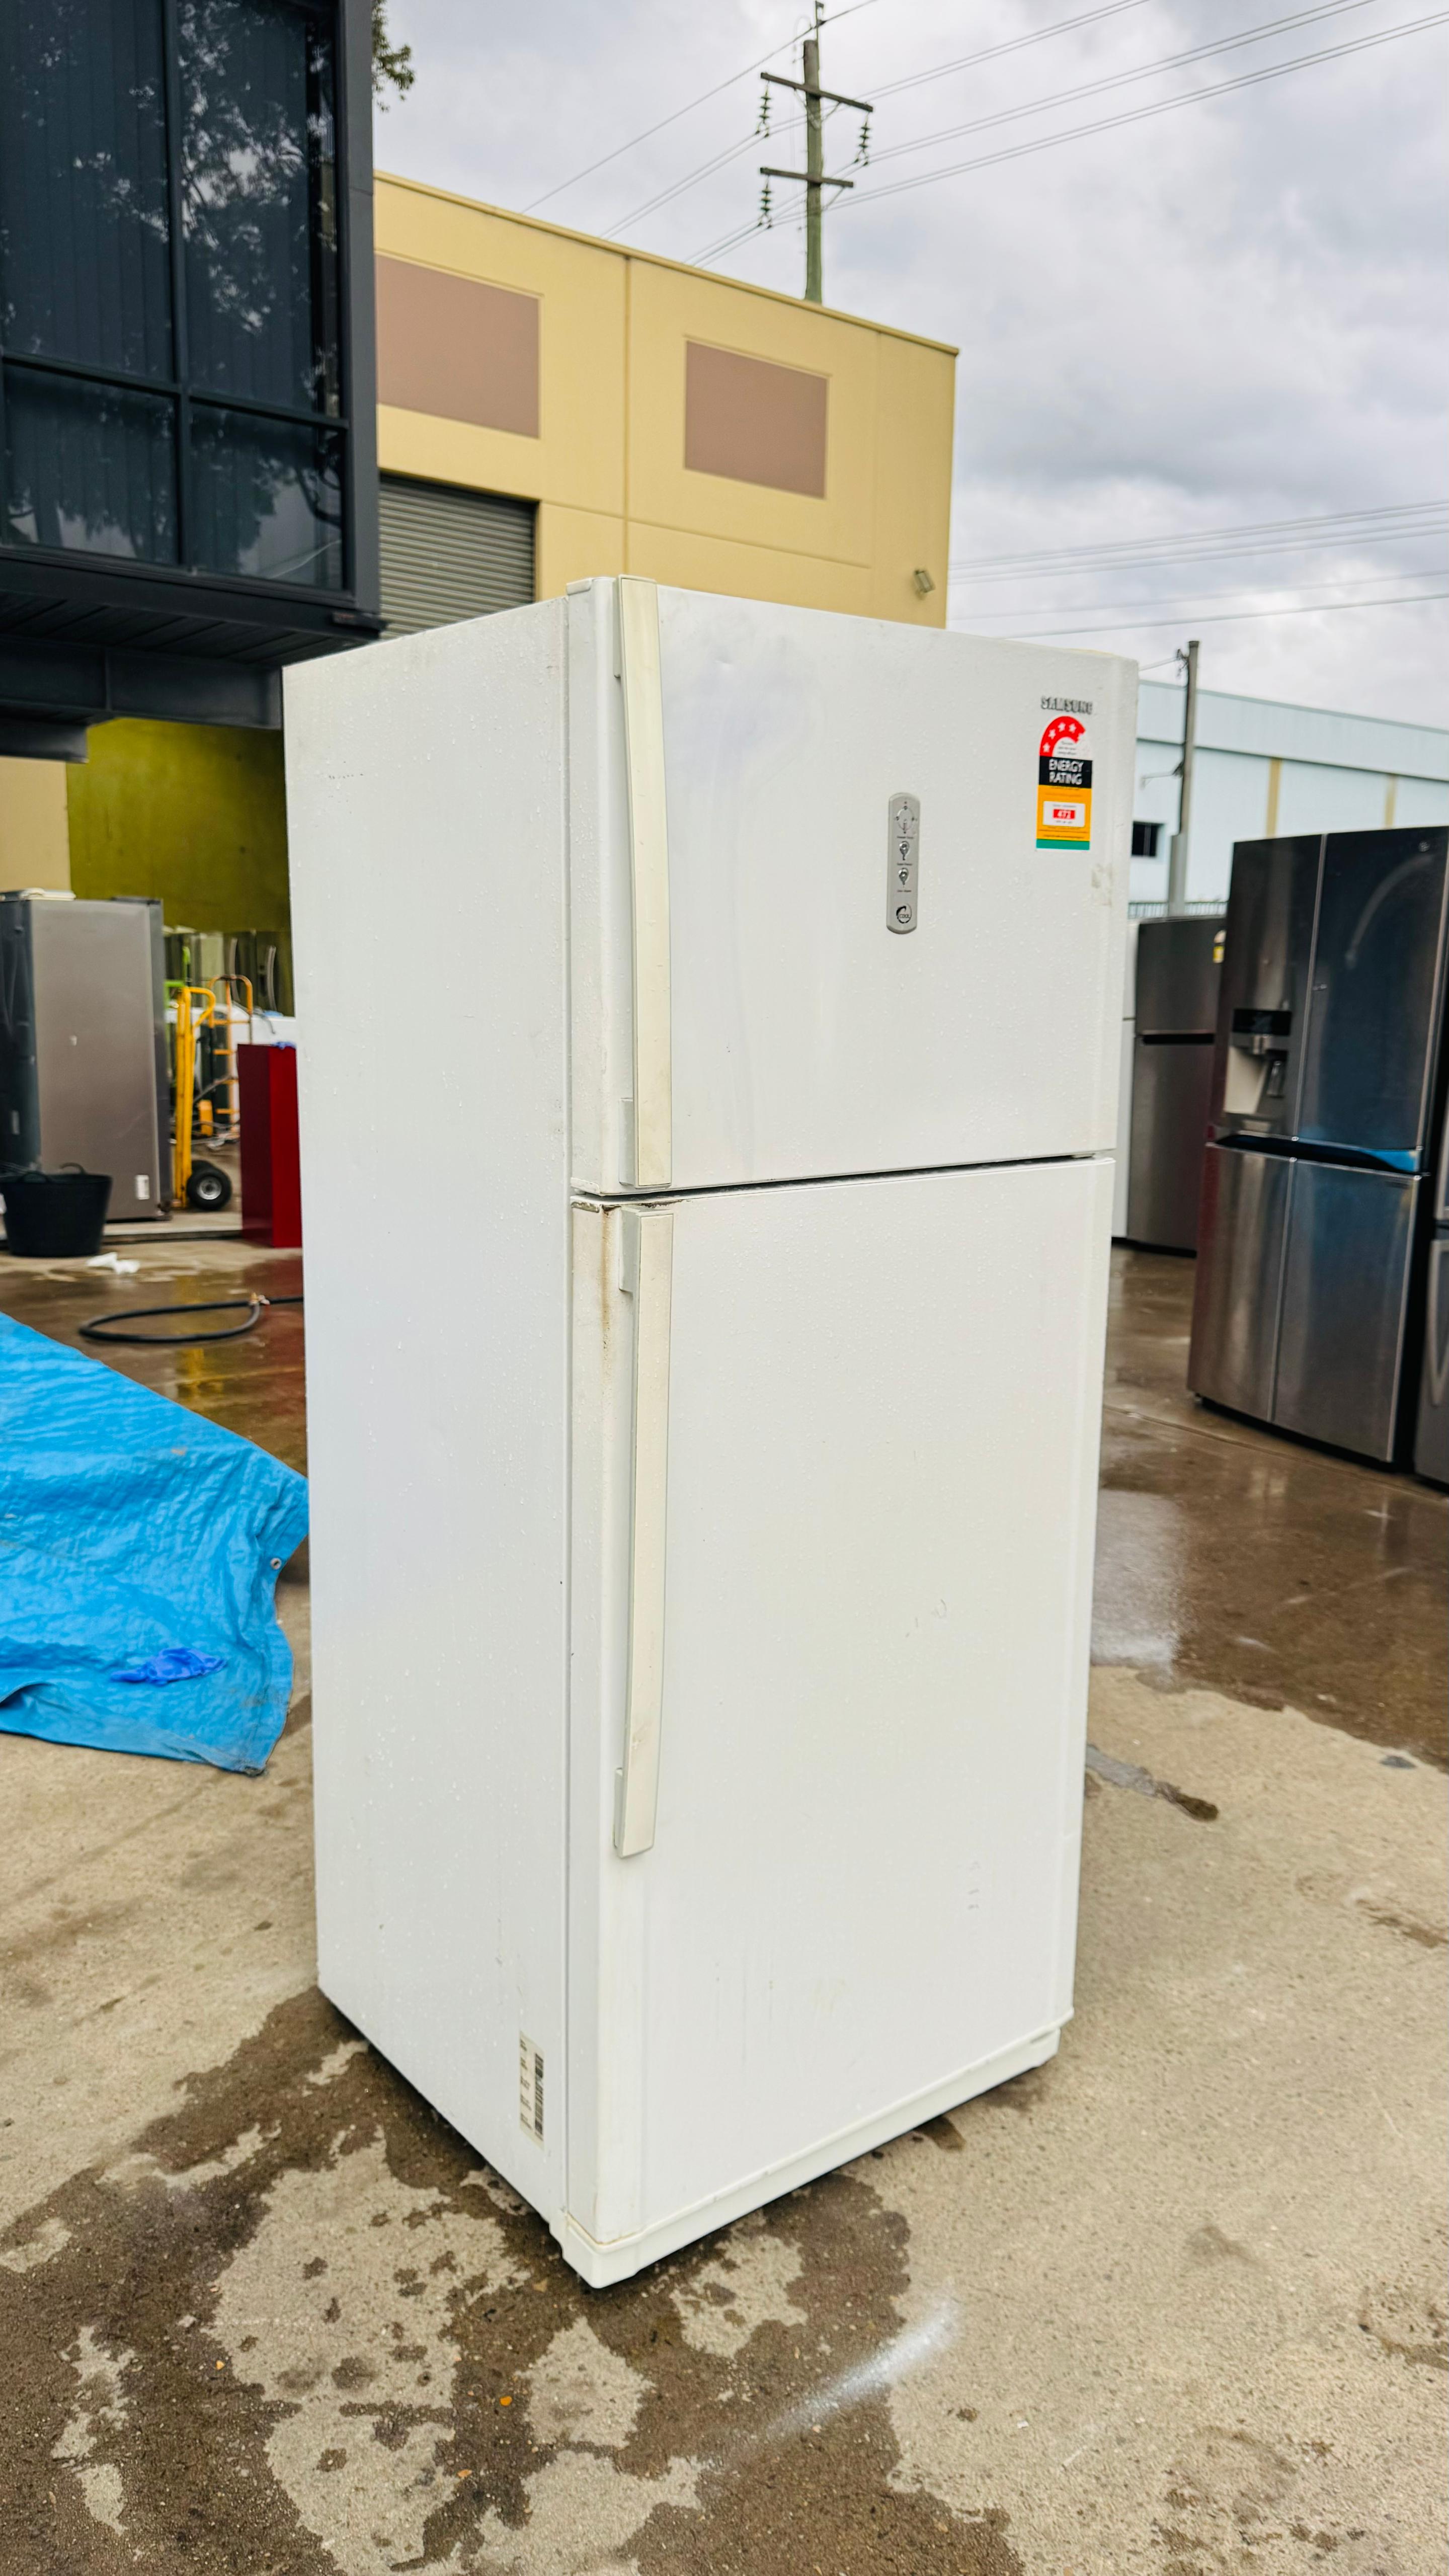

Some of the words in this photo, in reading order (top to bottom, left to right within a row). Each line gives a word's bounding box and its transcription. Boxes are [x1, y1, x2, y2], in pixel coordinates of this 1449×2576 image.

[1041, 696, 1092, 714] SAMSUNG
[1049, 759, 1084, 772] ENERGY
[1049, 771, 1082, 785] RATING
